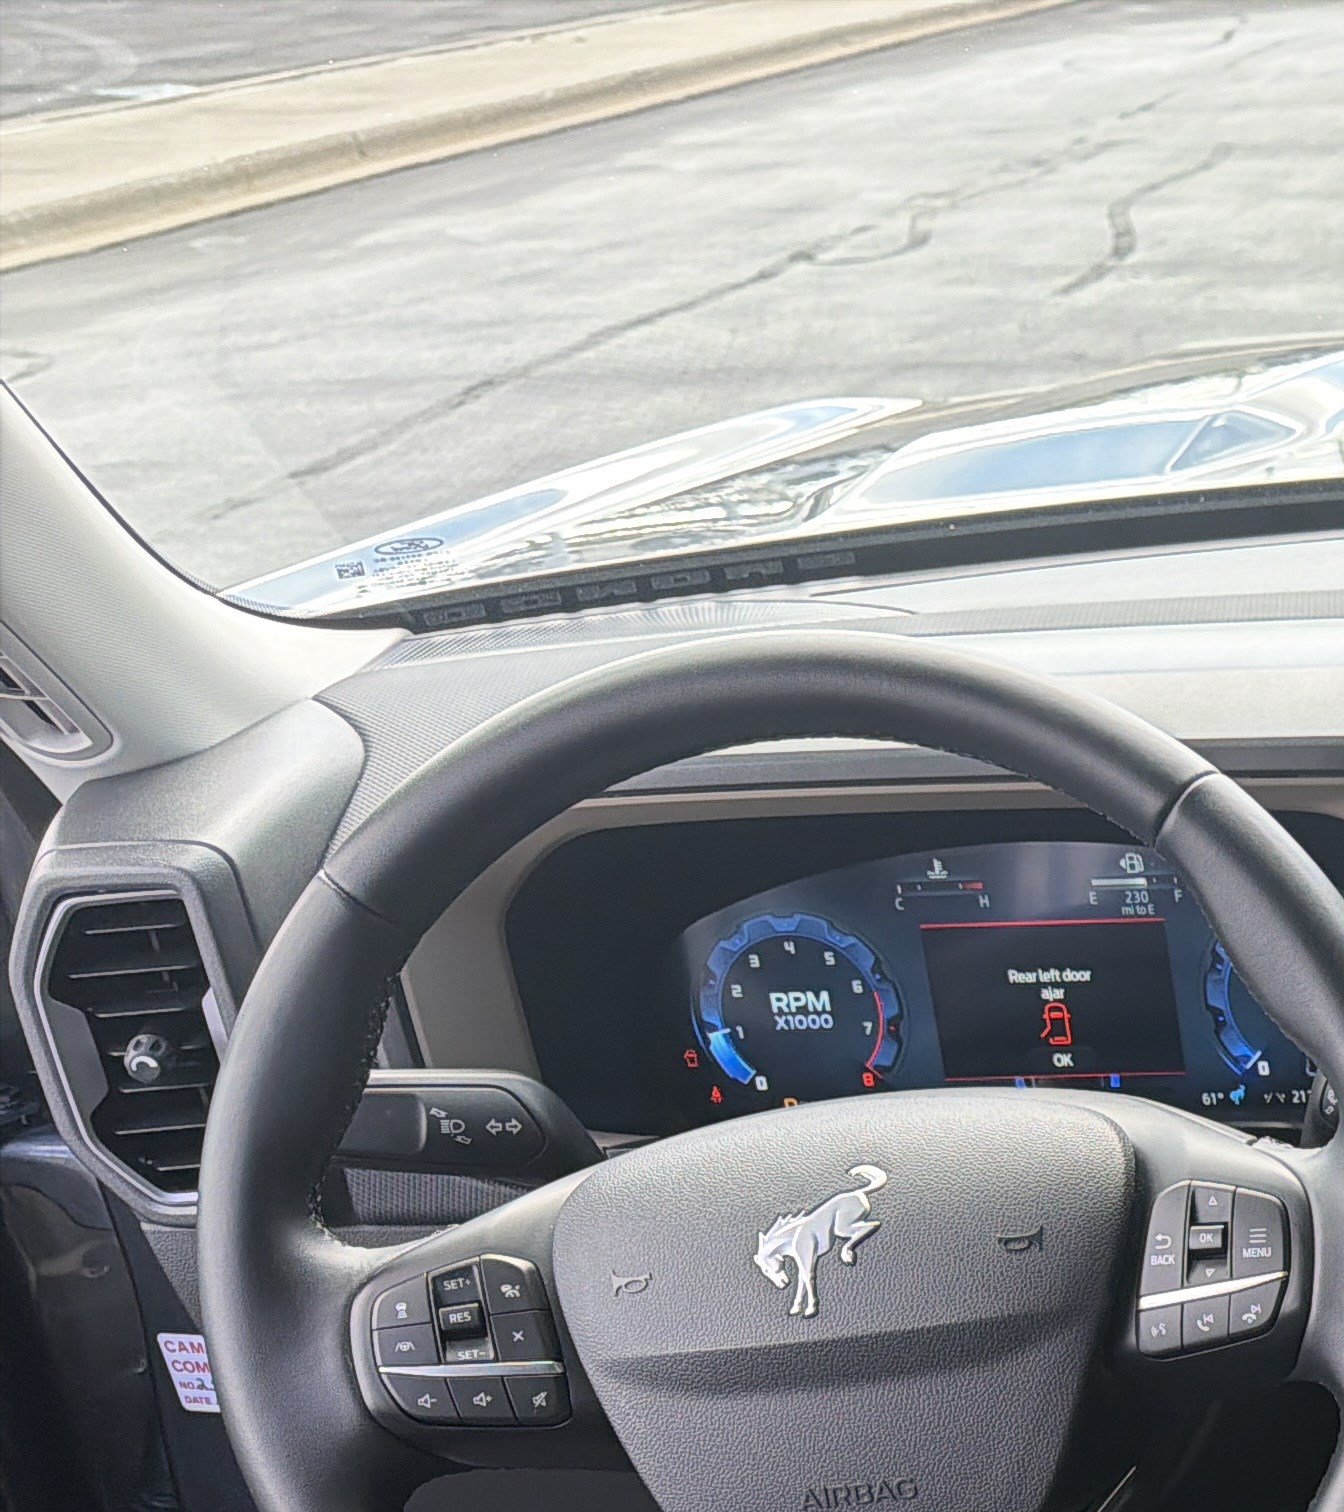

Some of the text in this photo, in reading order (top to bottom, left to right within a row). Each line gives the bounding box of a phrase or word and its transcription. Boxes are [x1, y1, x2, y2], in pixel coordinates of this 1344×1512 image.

[979, 895, 990, 908] H
[1089, 892, 1098, 905] E
[1125, 891, 1149, 904] 230
[1174, 890, 1183, 903] F
[895, 898, 905, 911] C
[1121, 904, 1155, 916] mi to E
[784, 941, 796, 954] 4
[749, 954, 760, 968] 3
[824, 952, 835, 966] 5
[1007, 966, 1092, 984] Rear left door
[731, 984, 743, 998] 2
[852, 980, 863, 994] 6
[1040, 985, 1065, 1001] ajar
[769, 990, 832, 1013] RPM
[775, 1013, 834, 1031] X1000
[862, 1021, 873, 1036] 7
[736, 1025, 745, 1039] 1
[1053, 1053, 1074, 1068] OK
[1257, 1061, 1270, 1076] 0
[756, 1076, 769, 1091] 0
[863, 1073, 875, 1088] 8
[1199, 1232, 1213, 1243] OK
[1242, 1247, 1272, 1258] MENU
[1150, 1254, 1176, 1266] BACK
[449, 1311, 472, 1324] RES
[801, 1477, 920, 1512] AIRBAG
